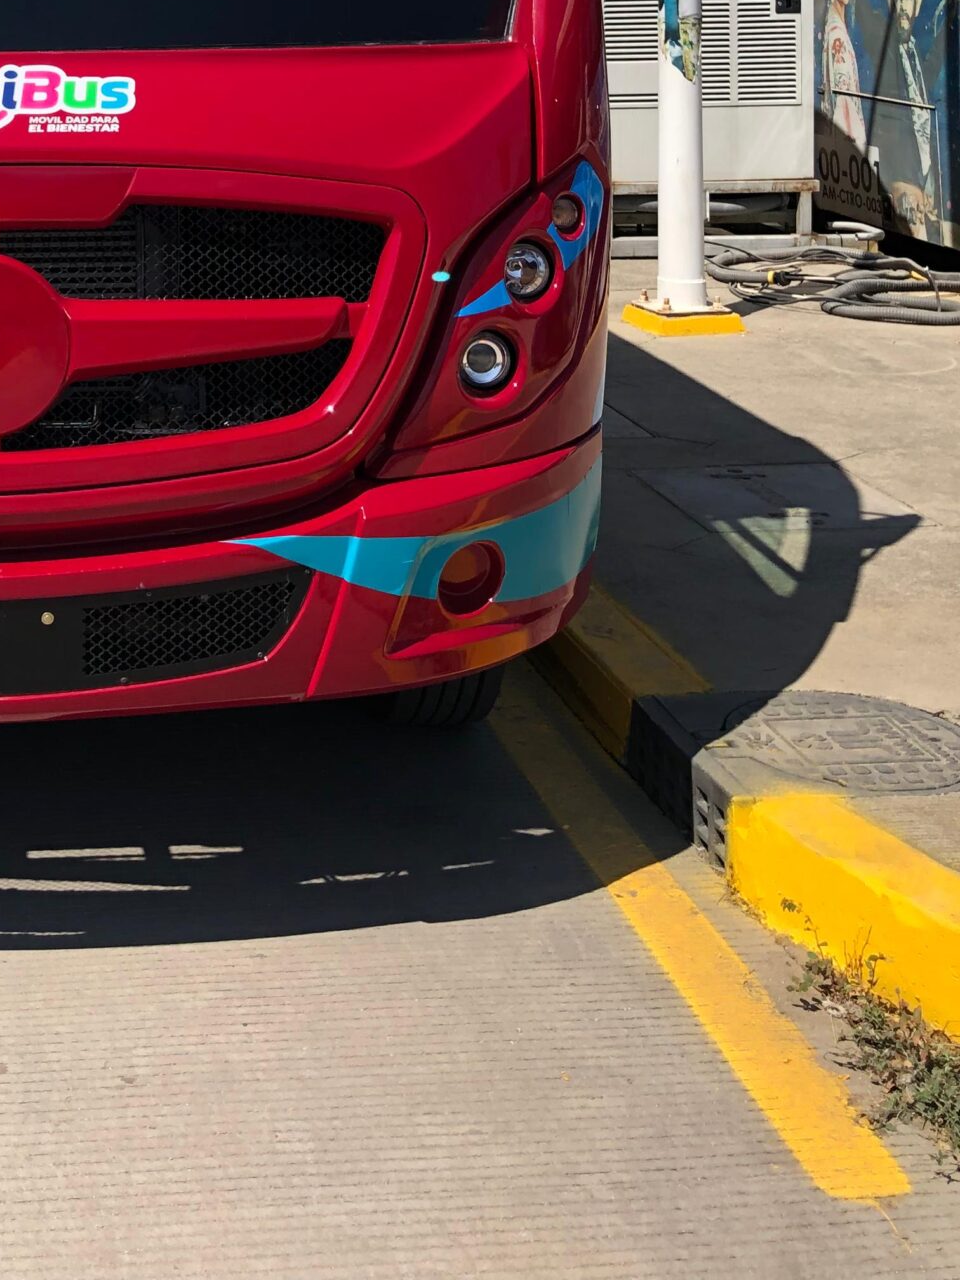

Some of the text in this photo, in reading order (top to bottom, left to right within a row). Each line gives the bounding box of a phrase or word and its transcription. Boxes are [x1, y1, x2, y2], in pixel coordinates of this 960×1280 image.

[90, 116, 120, 124] PARA
[28, 124, 120, 133] EL BIENESTAR
